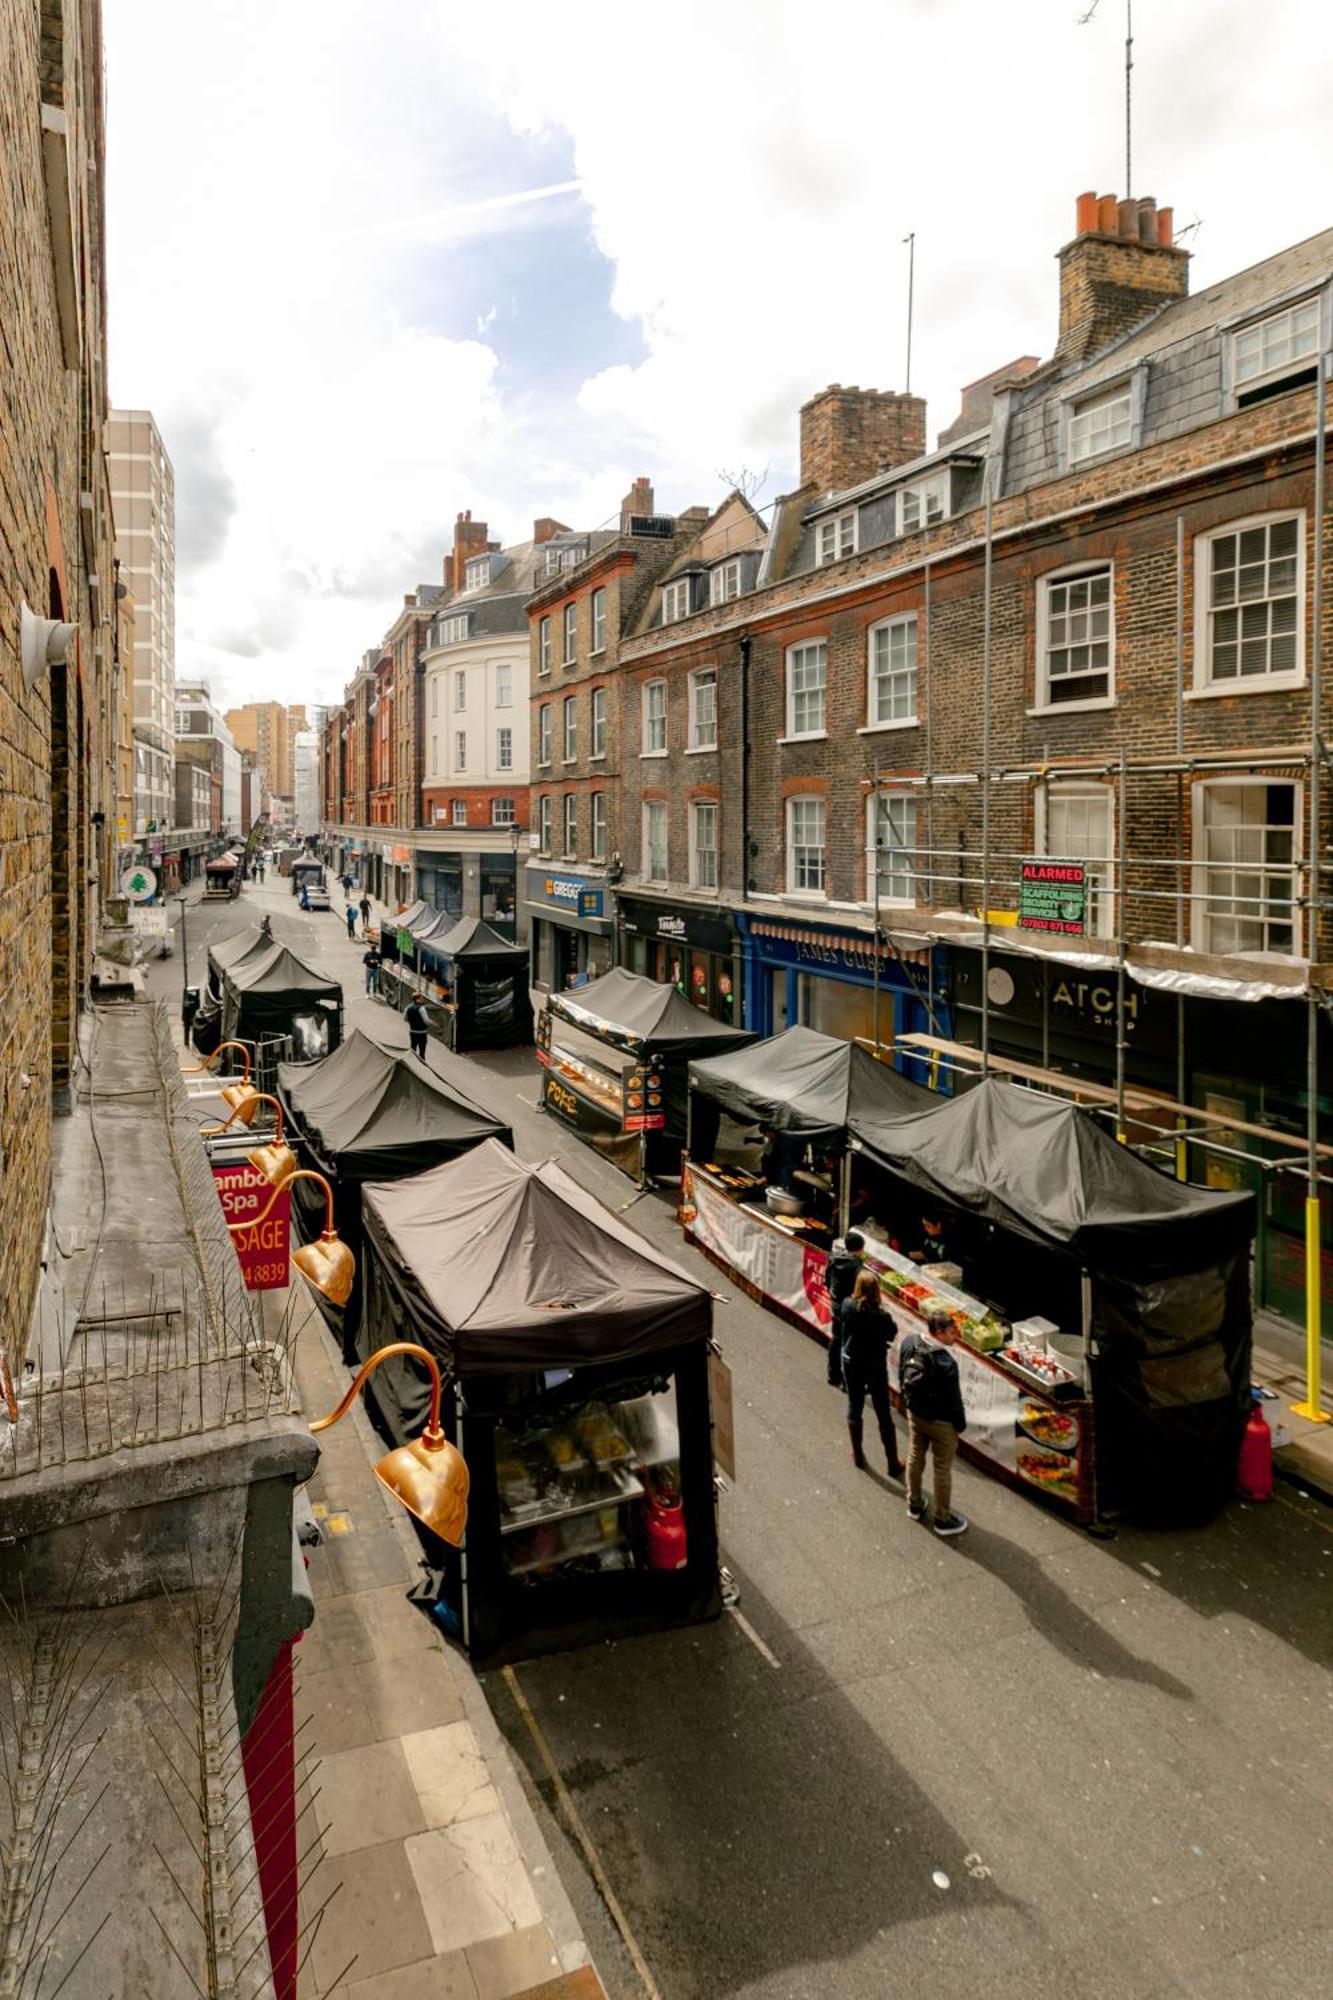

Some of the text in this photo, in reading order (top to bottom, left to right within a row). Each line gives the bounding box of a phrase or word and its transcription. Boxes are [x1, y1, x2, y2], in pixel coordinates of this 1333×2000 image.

[1023, 866, 1084, 881] ALARMED
[796, 943, 838, 964] JAMES
[1040, 982, 1137, 1018] ATCH
[1094, 1015, 1135, 1031] SHP
[214, 1169, 269, 1190] ambo
[222, 1192, 259, 1215] Spa
[230, 1220, 285, 1253] SAGE
[254, 1262, 286, 1283] 8839
